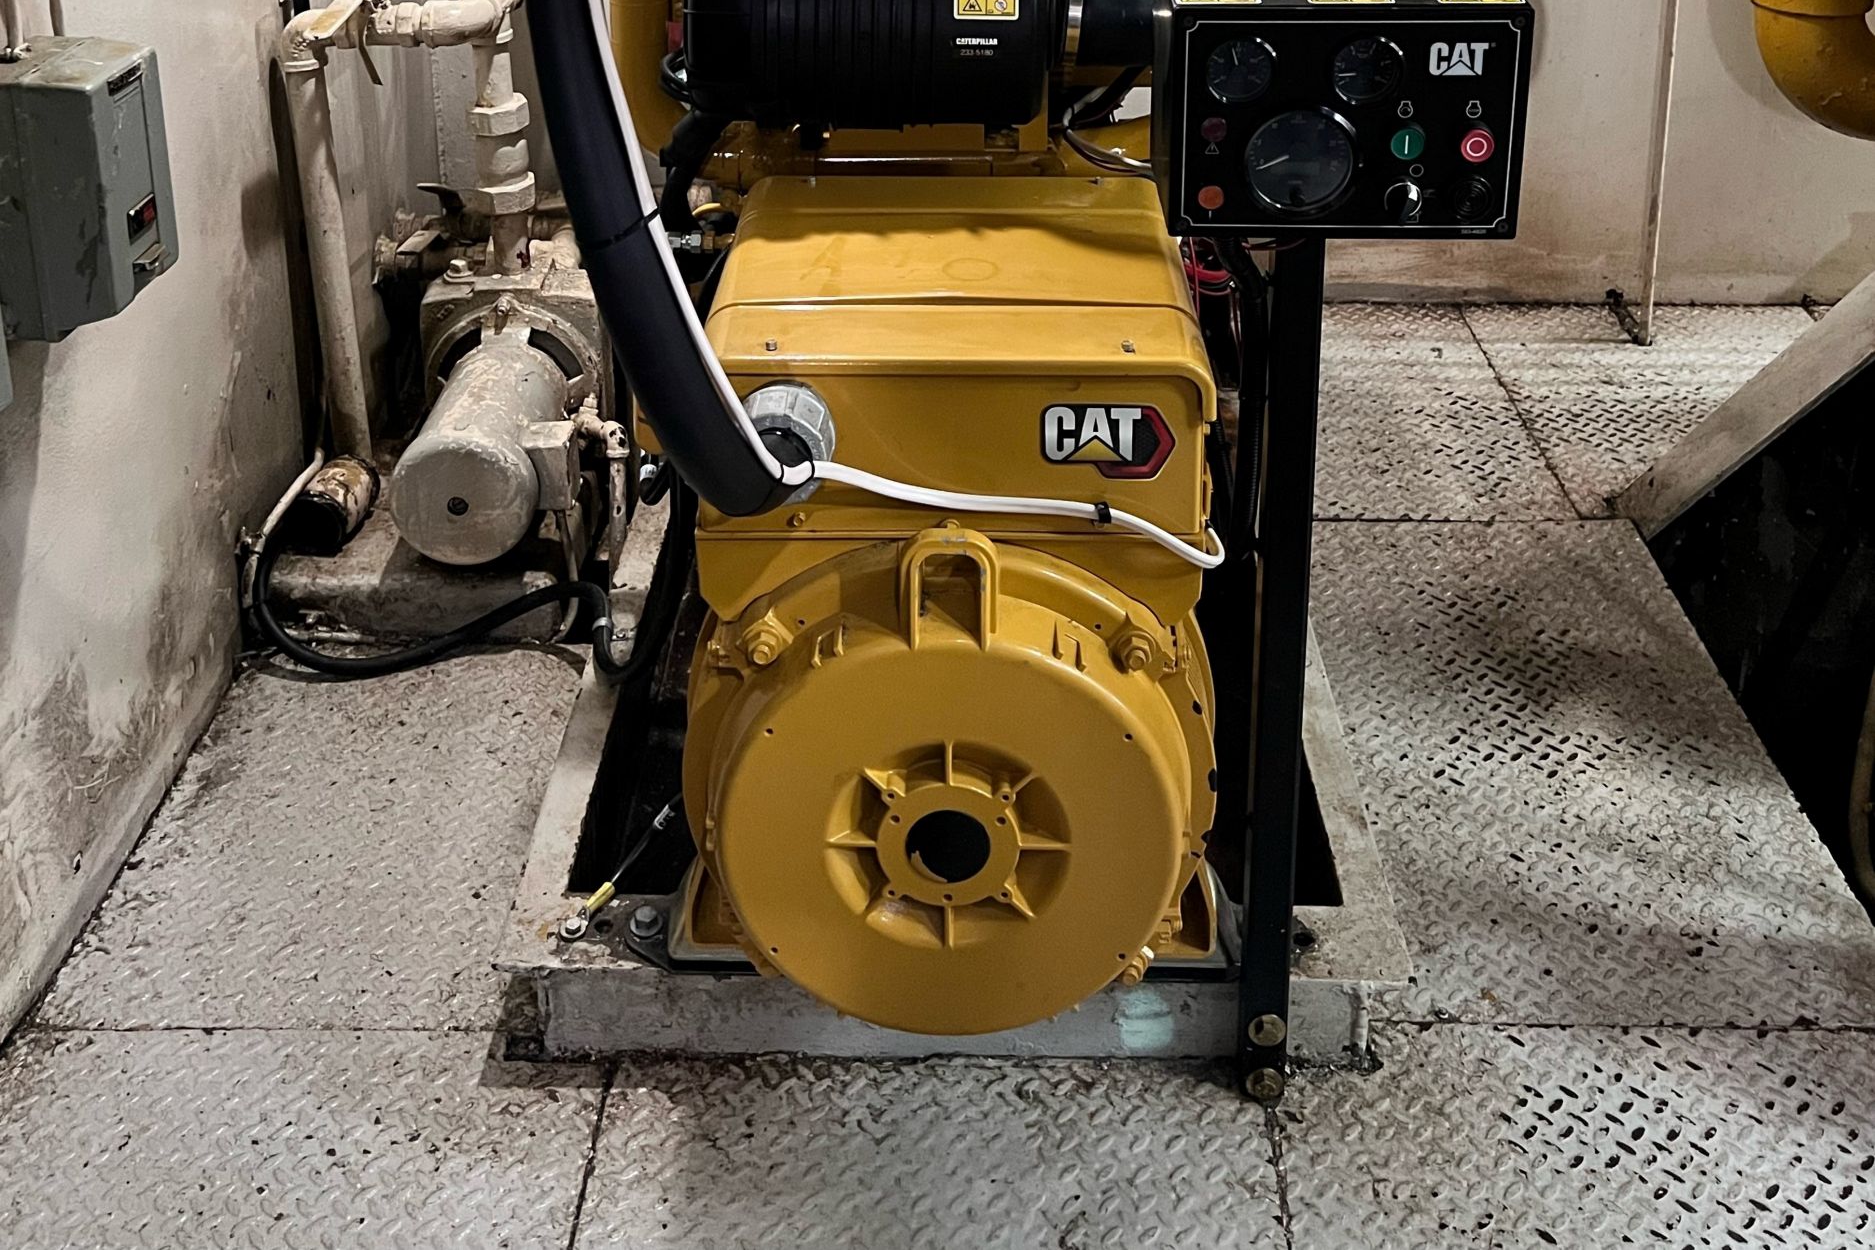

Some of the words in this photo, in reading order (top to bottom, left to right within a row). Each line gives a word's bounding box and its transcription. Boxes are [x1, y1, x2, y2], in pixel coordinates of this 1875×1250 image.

[956, 37, 998, 46] CATERPILLAR
[1429, 42, 1489, 76] CAT
[1045, 406, 1142, 461] CAT
